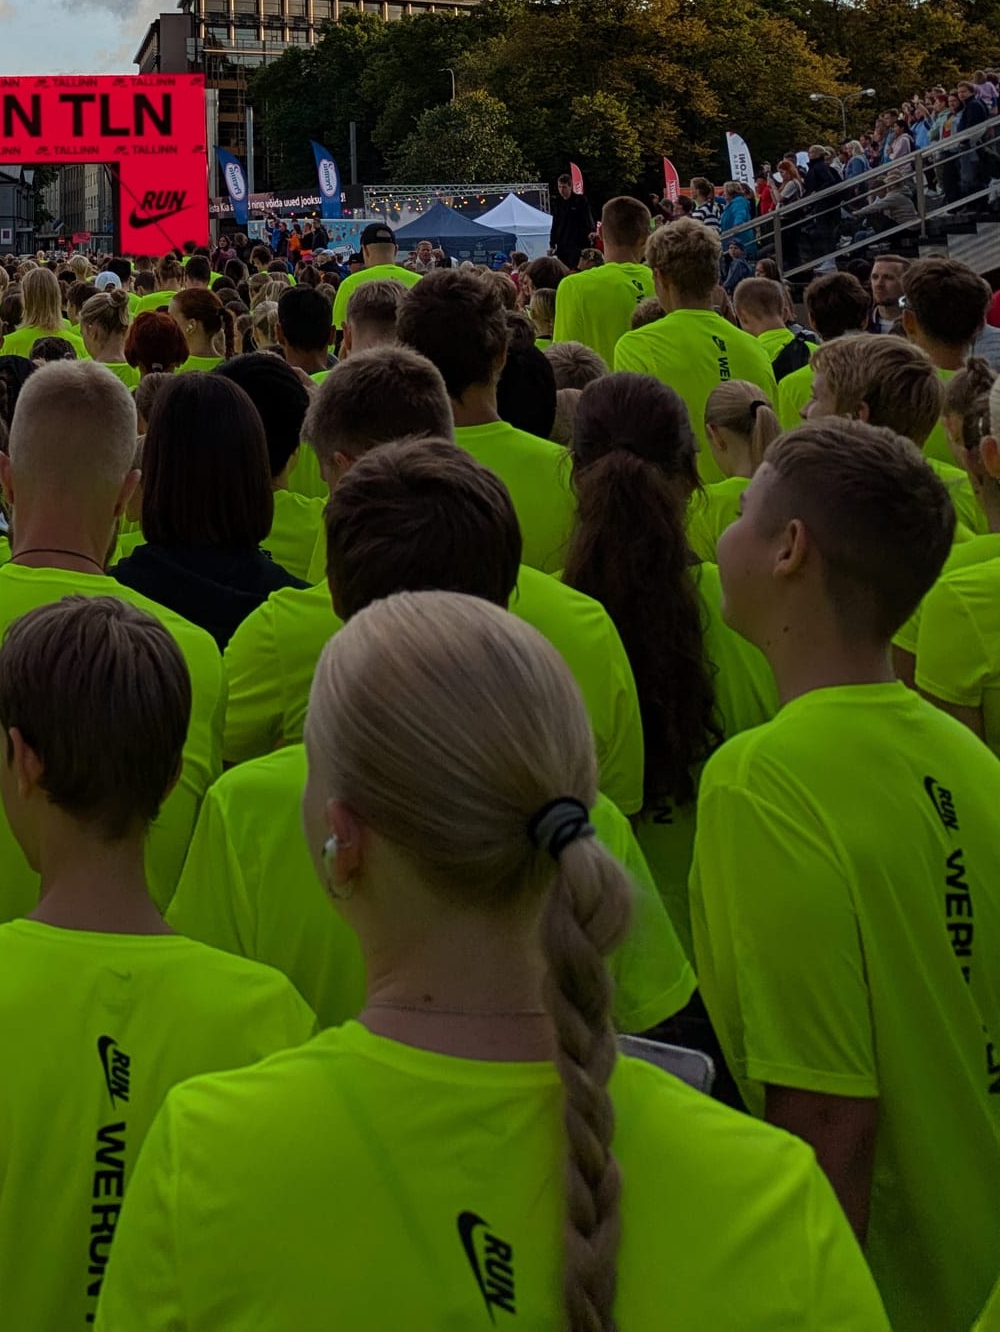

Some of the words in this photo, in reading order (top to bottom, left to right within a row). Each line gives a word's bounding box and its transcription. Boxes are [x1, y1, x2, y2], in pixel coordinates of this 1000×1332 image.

[52, 78, 98, 87] TALLINN
[130, 77, 176, 86] TALLINN
[59, 93, 172, 137] TLN
[53, 146, 99, 155] TALLINN
[132, 145, 178, 154] TALLINN
[141, 190, 186, 210] RUN
[252, 200, 264, 211] ning
[284, 196, 299, 207] uued
[936, 786, 960, 831] RUN
[111, 1048, 130, 1102] RUN
[484, 1231, 516, 1316] RUN
